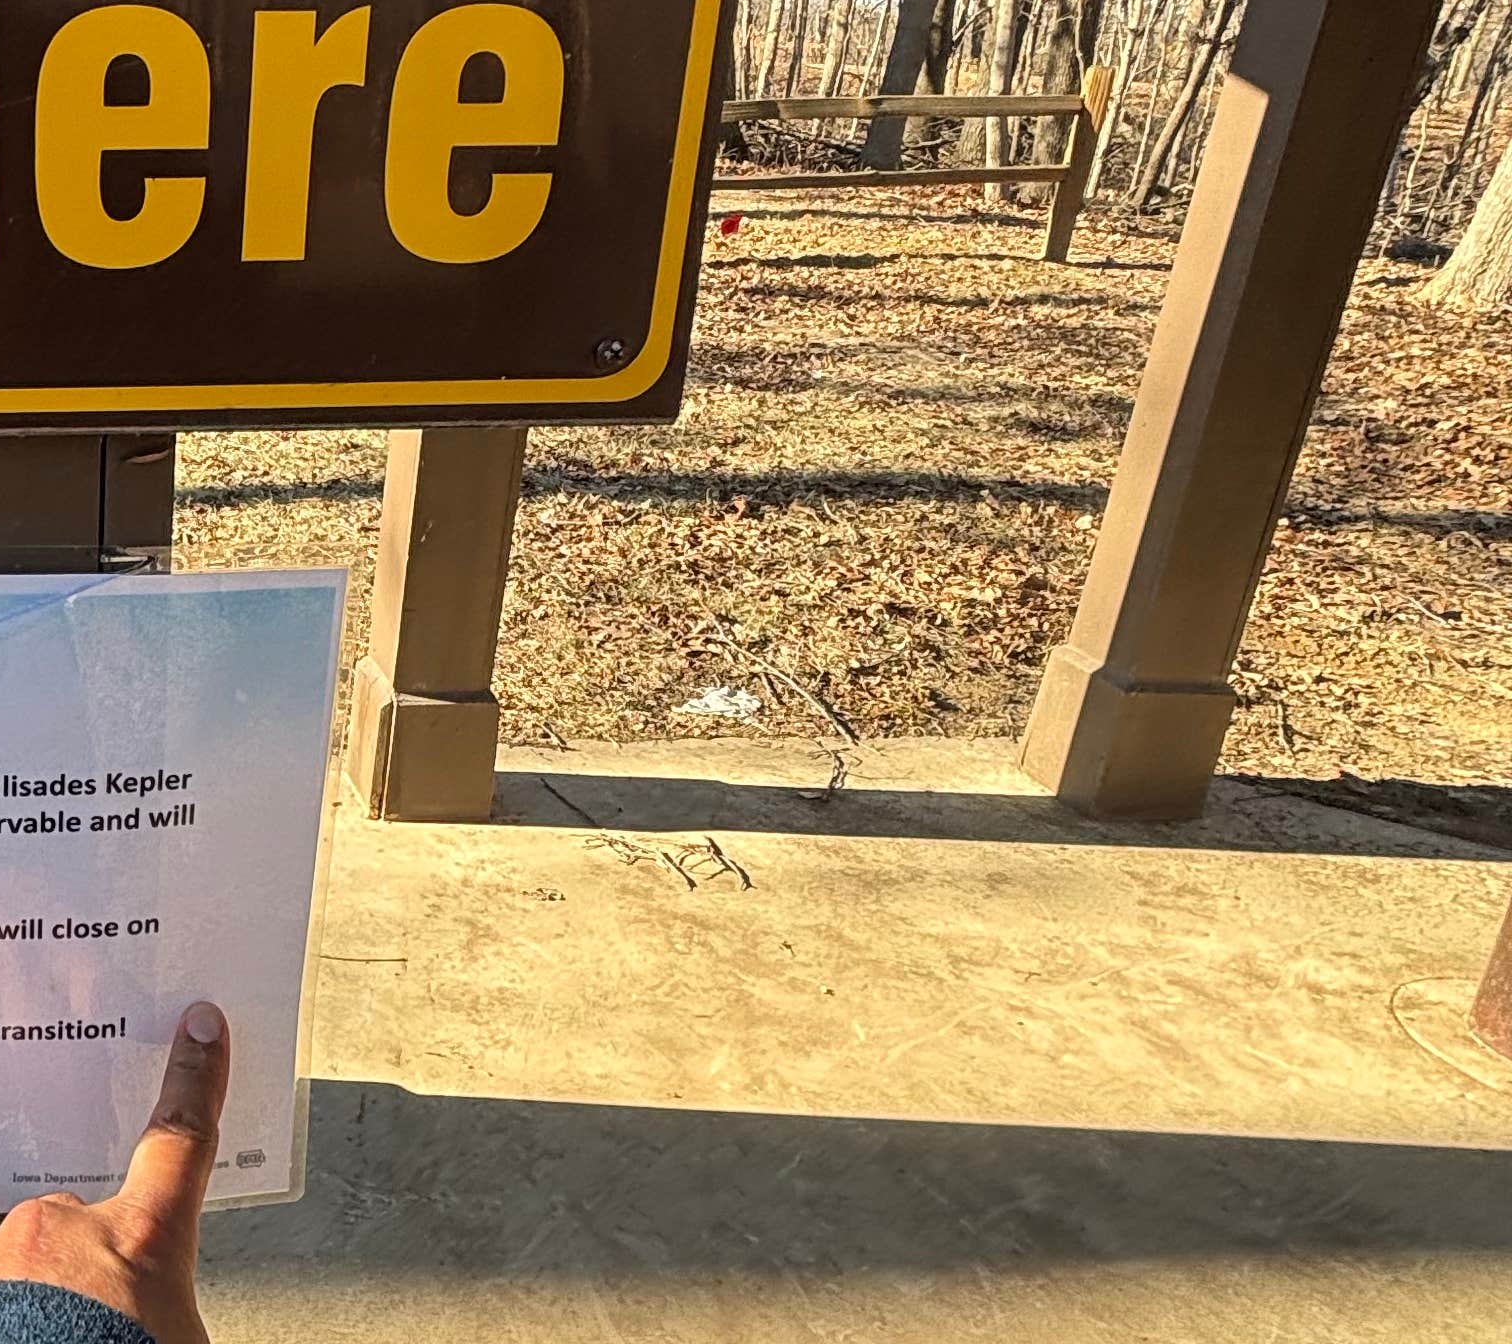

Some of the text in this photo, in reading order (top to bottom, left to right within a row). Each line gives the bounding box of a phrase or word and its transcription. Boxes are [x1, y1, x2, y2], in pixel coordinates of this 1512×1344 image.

[106, 768, 193, 798] Kepler
[90, 806, 140, 832] and
[149, 804, 196, 829] will
[52, 917, 119, 940] close
[127, 917, 160, 936] on
[12, 1172, 41, 1183] Iowa
[44, 1172, 114, 1185] Department
